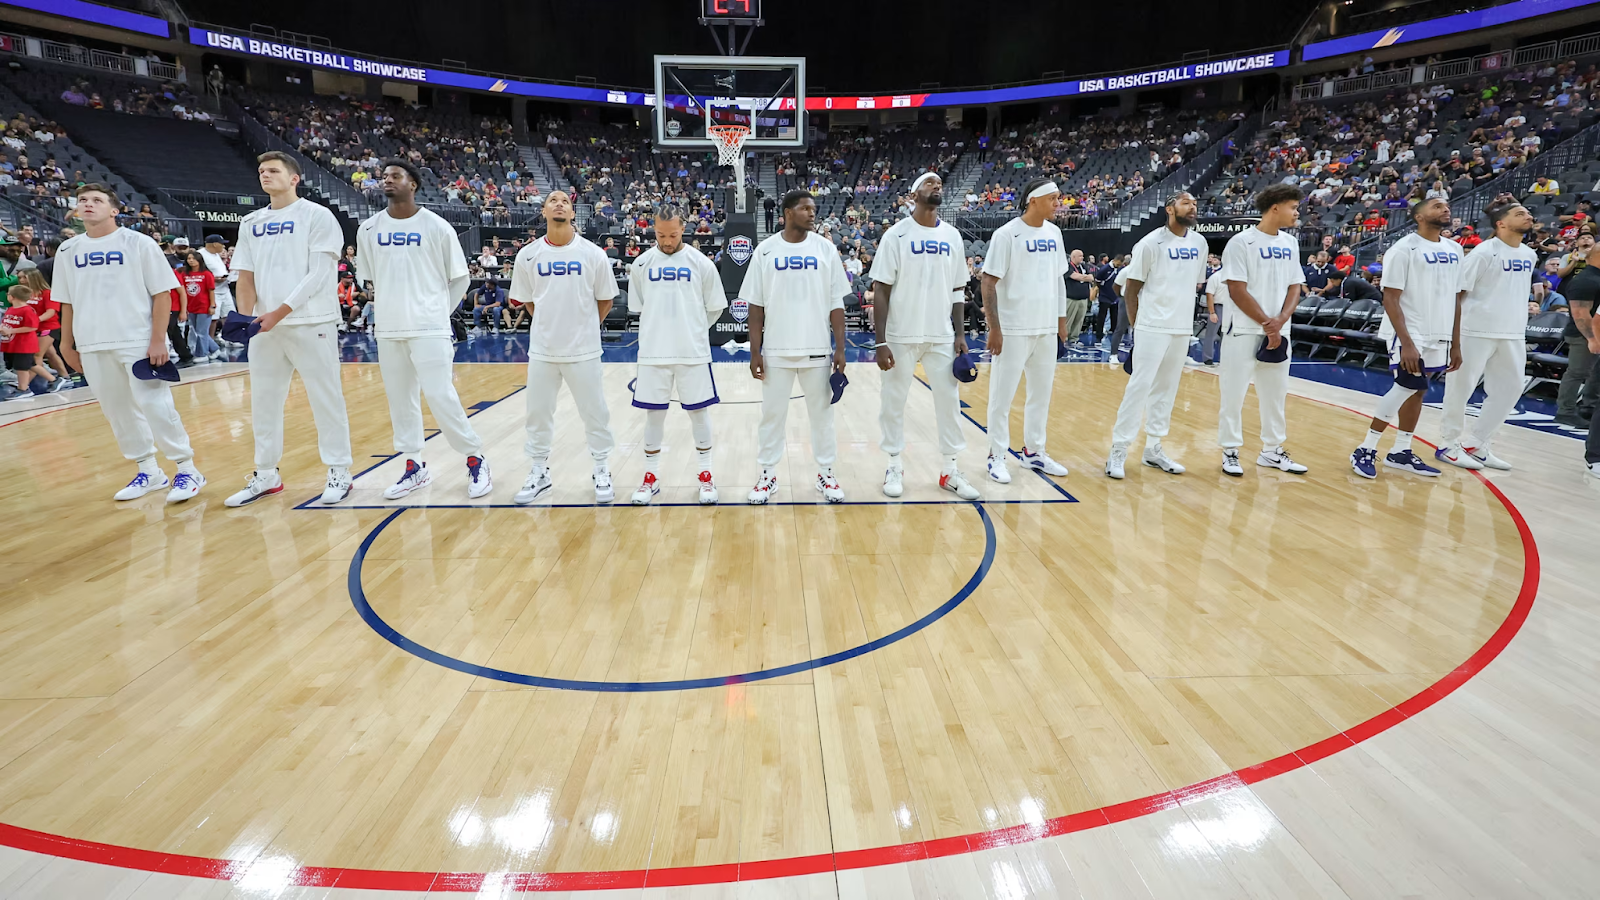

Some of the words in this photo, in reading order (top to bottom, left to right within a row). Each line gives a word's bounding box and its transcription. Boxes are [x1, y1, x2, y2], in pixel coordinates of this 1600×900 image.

[207, 31, 246, 52] USA
[249, 39, 350, 70] BASKETBALL
[353, 58, 427, 81] SHOWCASE
[1486, 57, 1497, 68] 18
[1079, 79, 1104, 92] USA
[1108, 67, 1191, 90] BASKETBALL
[1195, 53, 1274, 77] SHOWCASE
[825, 97, 833, 109] 0
[863, 101, 868, 109] 2
[899, 99, 904, 107] 0
[207, 211, 243, 222] Mobile
[253, 221, 295, 237] USA
[1195, 223, 1225, 232] Mobile
[378, 232, 422, 246] USA
[732, 240, 748, 248] USA
[1026, 238, 1057, 253] USA
[911, 240, 951, 256] USA
[1168, 248, 1199, 261] USA
[1259, 246, 1292, 260] USA
[75, 251, 124, 268] USA
[775, 256, 818, 271] USA
[1423, 251, 1459, 264] USA
[537, 261, 582, 277] USA
[1502, 259, 1532, 272] USA
[649, 266, 692, 282] USA
[716, 323, 750, 332] SHOWC
